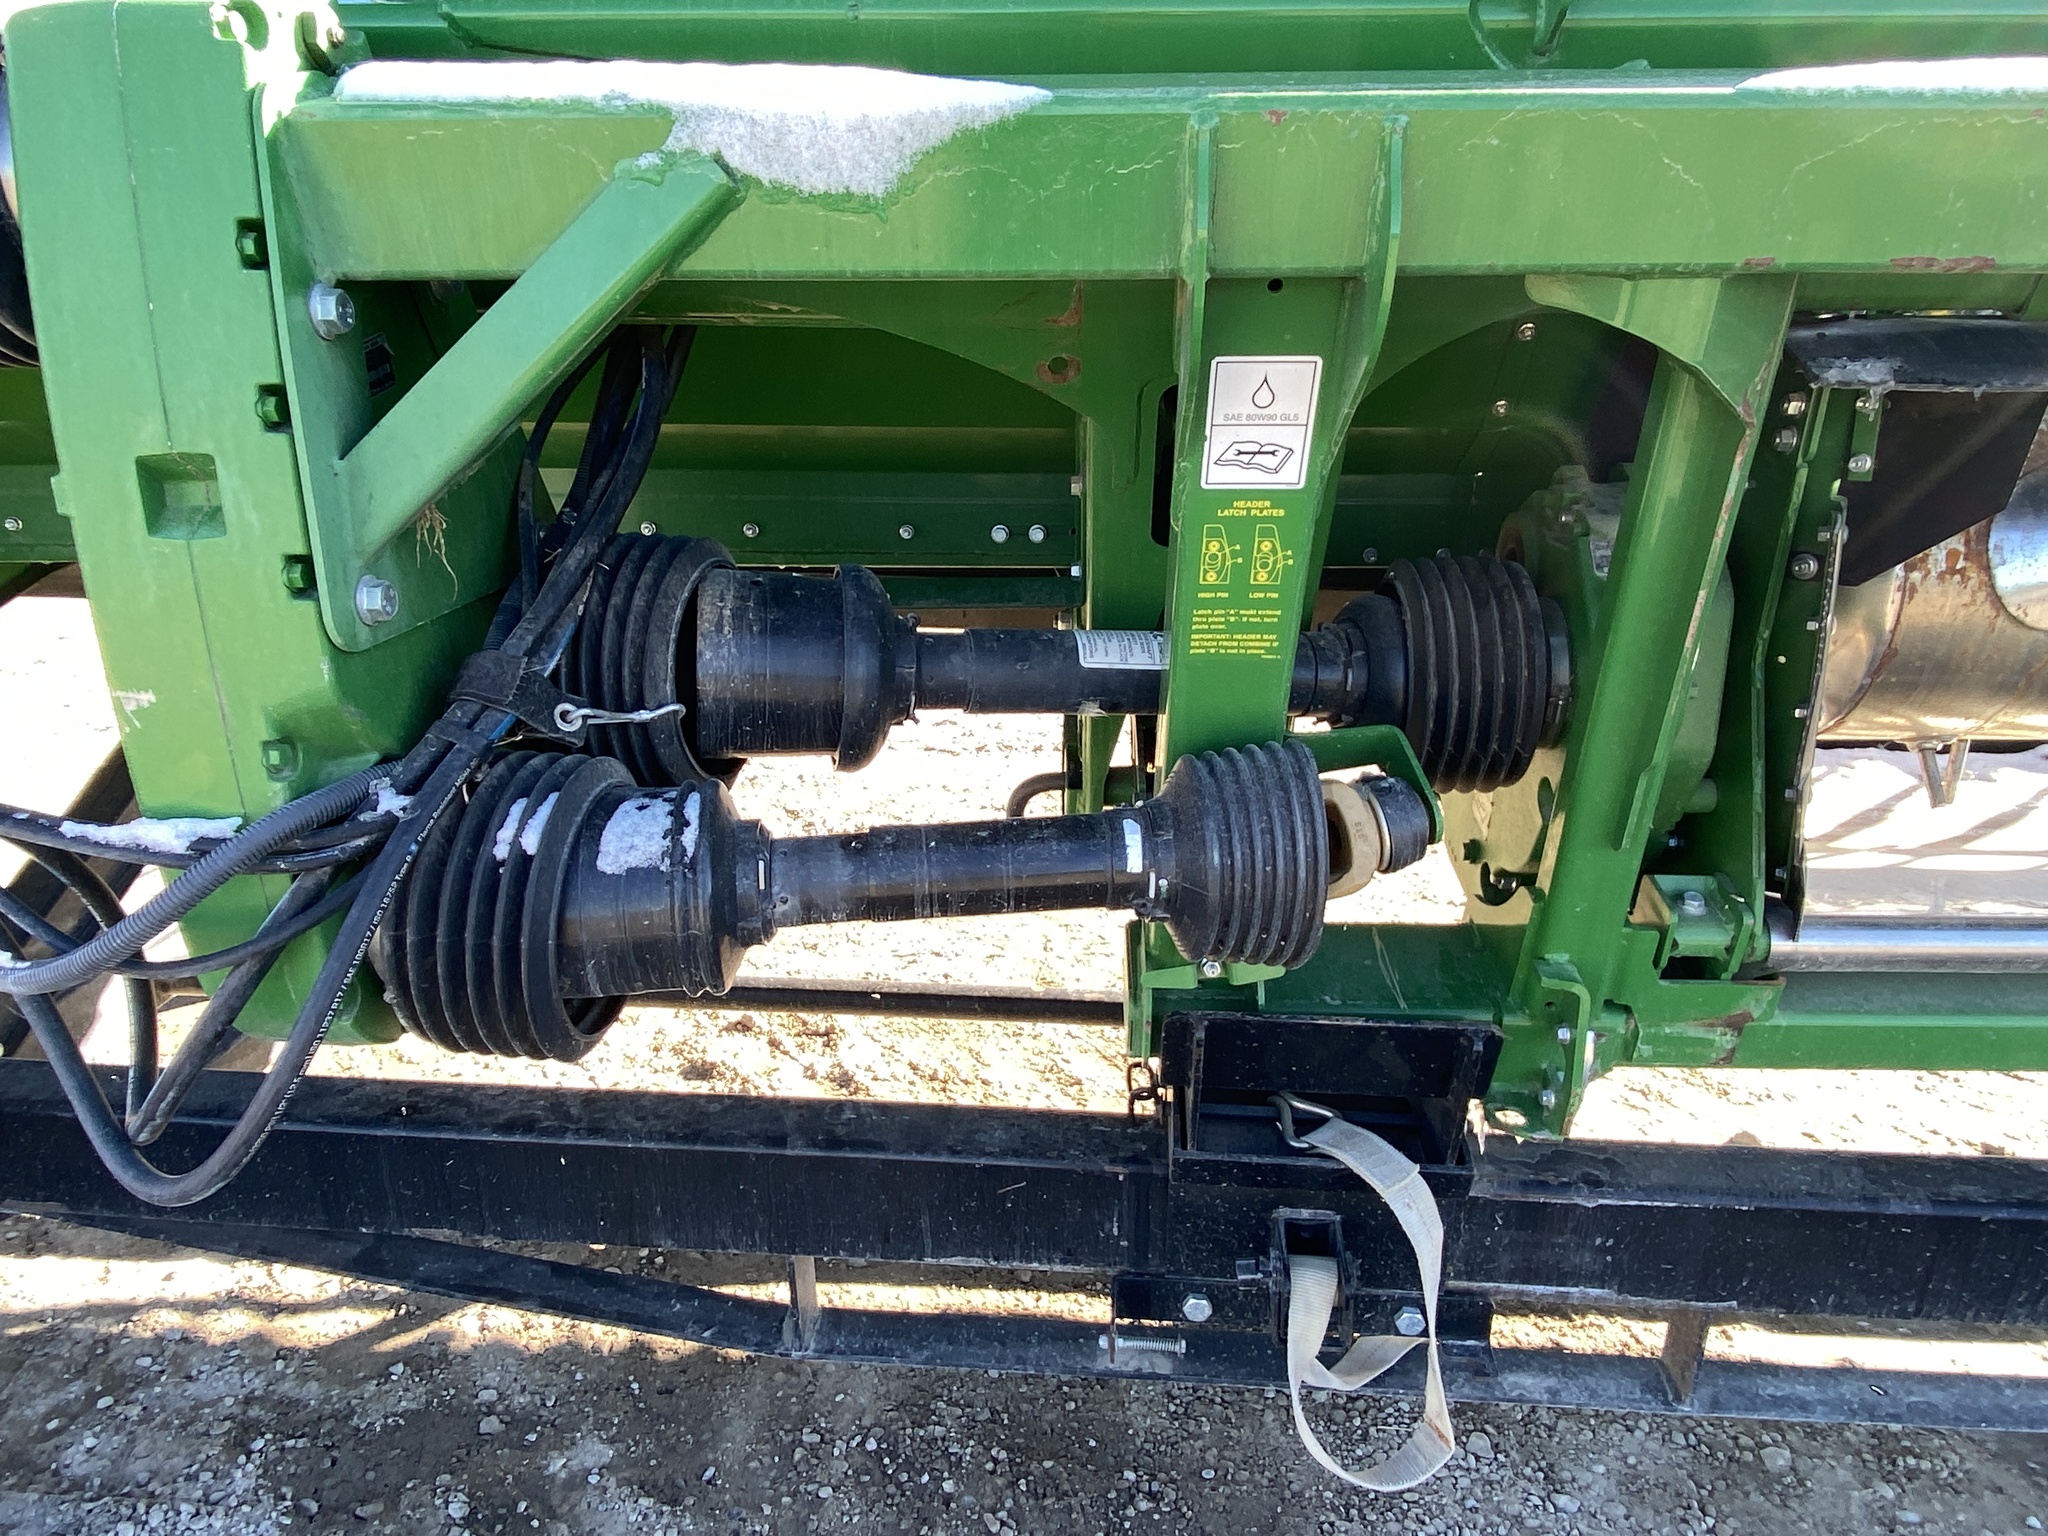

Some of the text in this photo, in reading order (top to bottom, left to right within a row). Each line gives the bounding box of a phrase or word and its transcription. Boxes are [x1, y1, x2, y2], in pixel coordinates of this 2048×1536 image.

[1223, 413, 1299, 421] SAE 80W90 GL5
[416, 818, 436, 841] Flame
